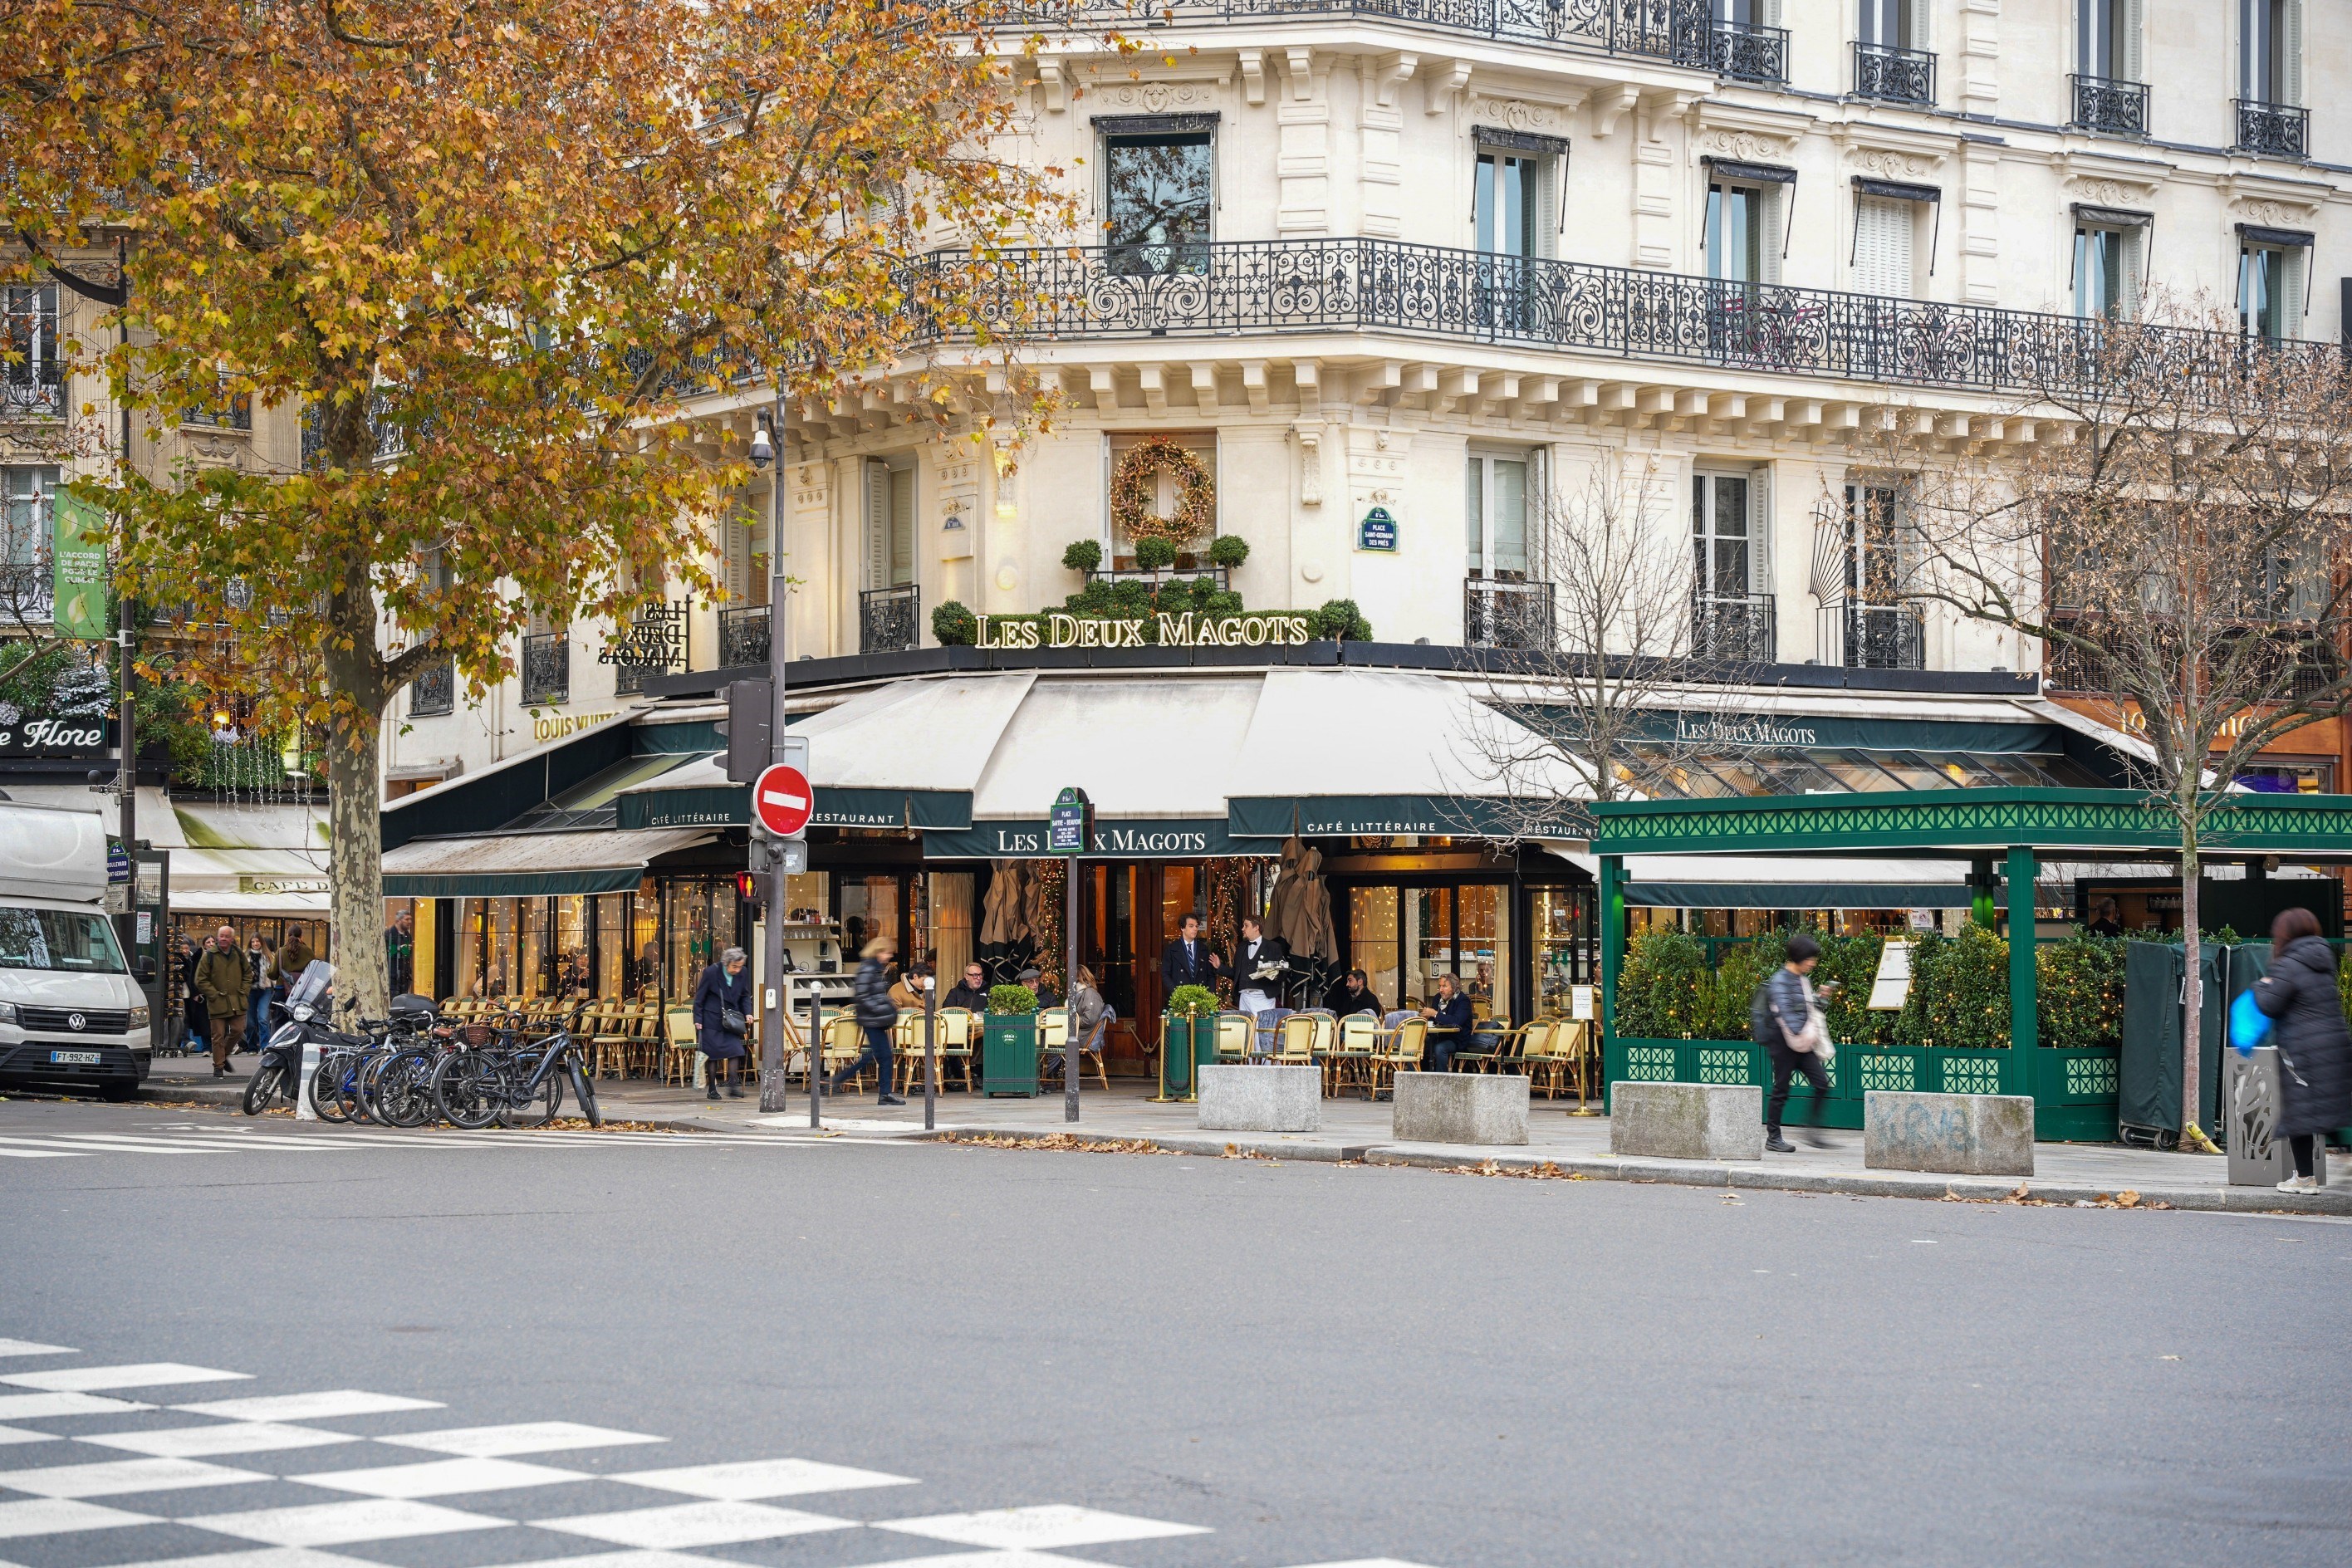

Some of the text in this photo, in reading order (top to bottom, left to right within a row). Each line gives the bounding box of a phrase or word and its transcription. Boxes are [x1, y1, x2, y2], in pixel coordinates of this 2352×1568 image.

[1365, 532, 1394, 540] SAINT-GERMAIN
[59, 551, 101, 560] L'ACCORD
[62, 567, 86, 576] POUR
[64, 576, 96, 584] CLIMAT
[974, 611, 1309, 650] LES DEUX MAGOTS
[22, 718, 102, 747] Flore
[534, 717, 572, 740] LOUIS
[1679, 720, 1816, 744] LES DEUX MAGOTS
[673, 811, 730, 823] LITTÉRAIRE
[809, 813, 894, 824] RESTAURANT
[1307, 821, 1437, 831] CAFÉ LITTÉRAIRE
[997, 831, 1038, 851] LES
[1111, 829, 1206, 850] MAGOTS
[56, 1052, 95, 1062] FT-992-HZ
